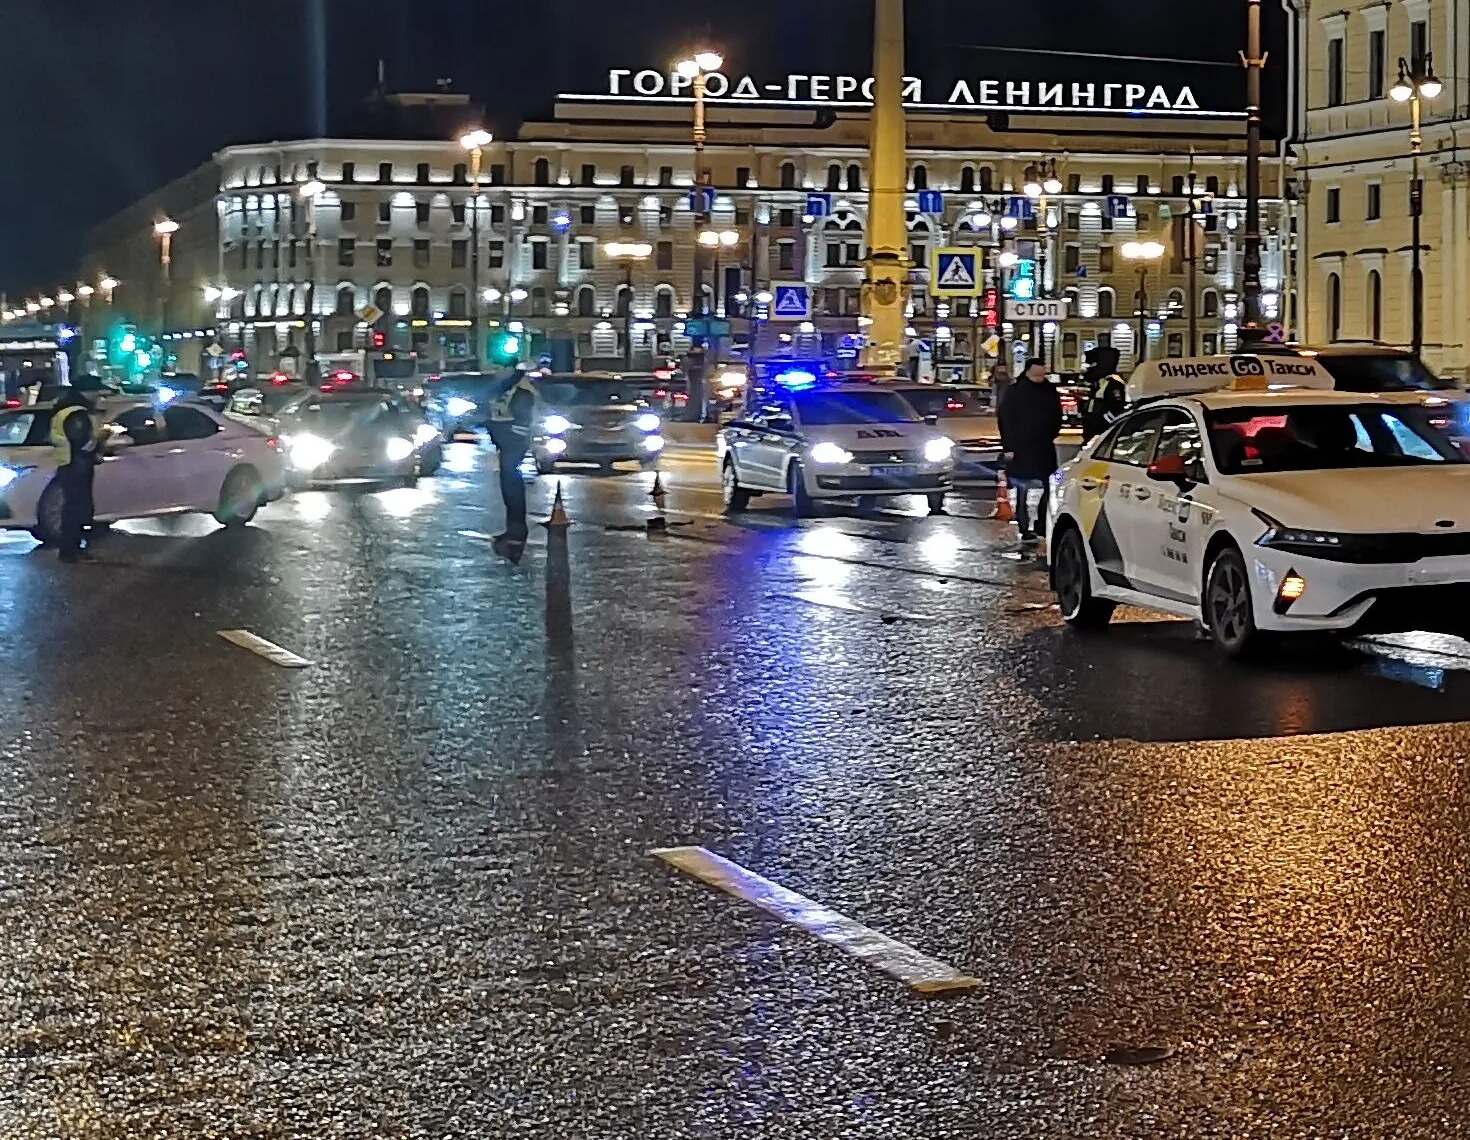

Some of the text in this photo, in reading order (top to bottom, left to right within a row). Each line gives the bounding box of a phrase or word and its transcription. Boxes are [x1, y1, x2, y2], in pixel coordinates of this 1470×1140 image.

[948, 79, 1200, 109] ЛЕНИНГРАД
[1015, 303, 1059, 316] СТОП
[1158, 359, 1317, 379] Яндекс Go Такси
